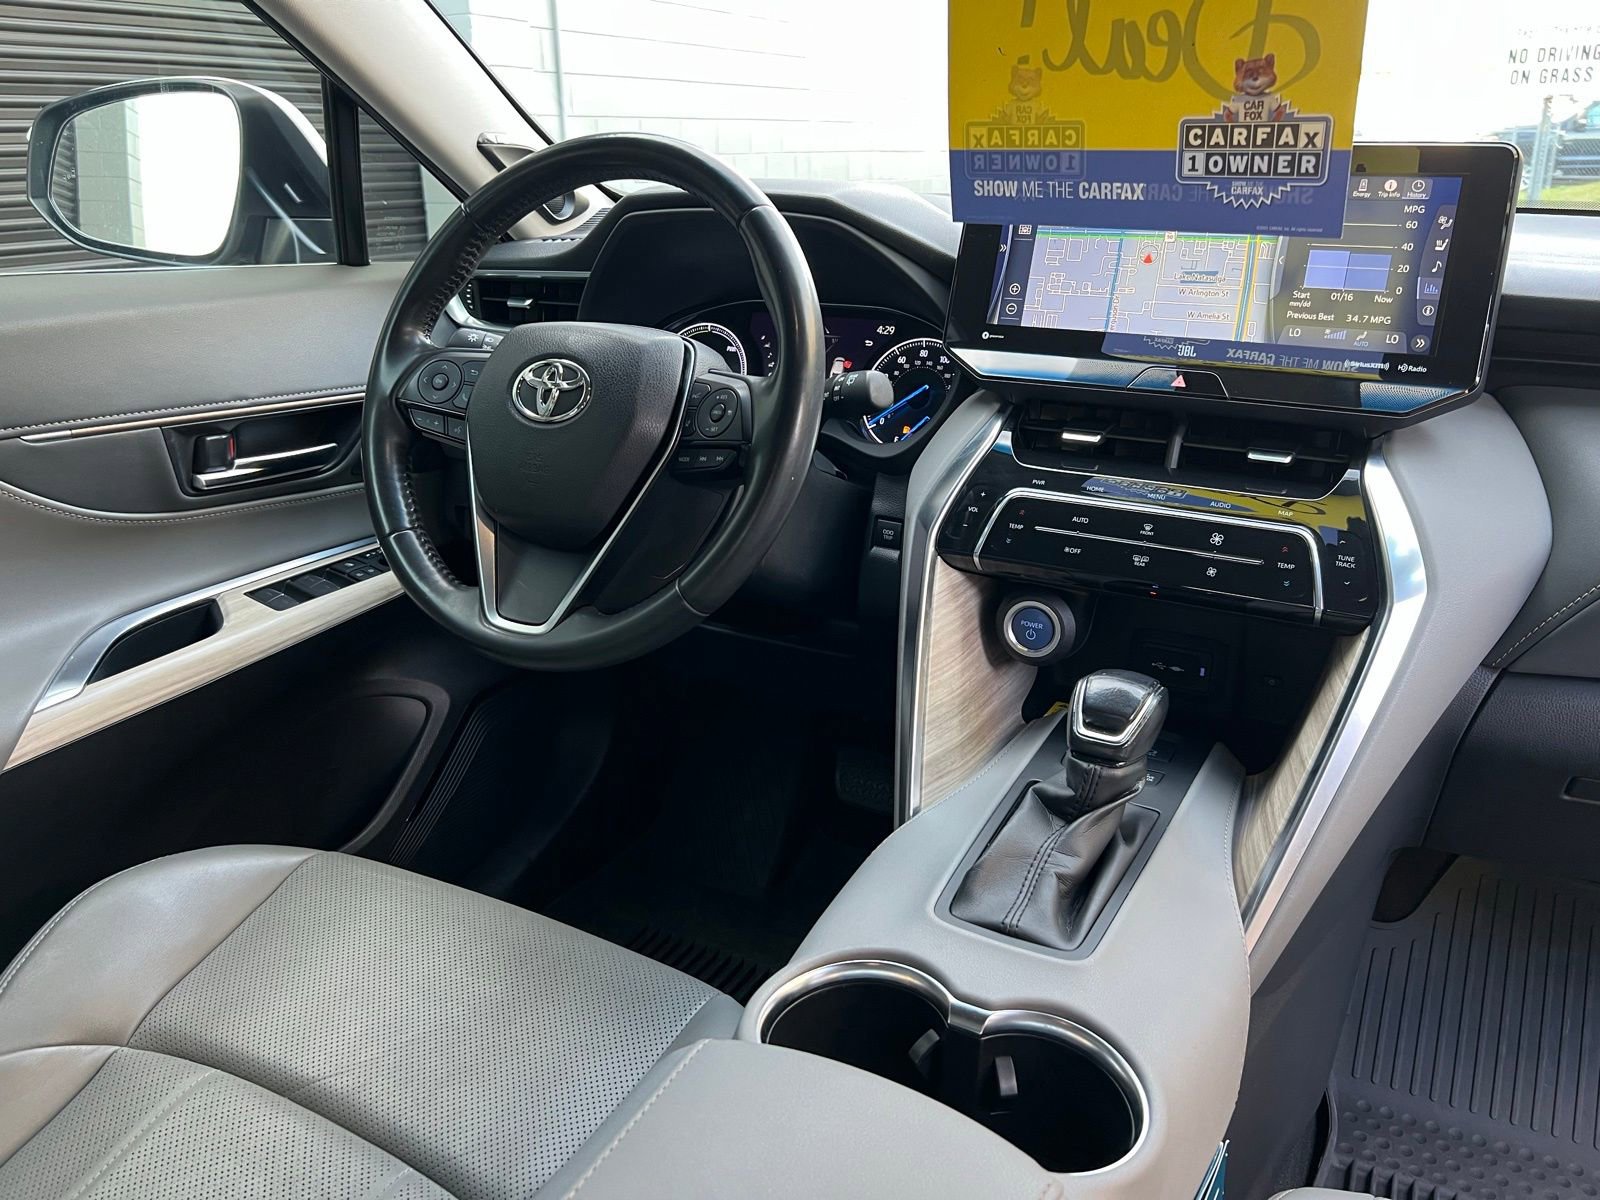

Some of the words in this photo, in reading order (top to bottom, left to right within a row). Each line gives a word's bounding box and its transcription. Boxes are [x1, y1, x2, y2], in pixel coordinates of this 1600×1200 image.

[1508, 48, 1528, 64] NO
[1510, 69, 1530, 85] ON
[1539, 66, 1594, 84] GRASS
[1243, 100, 1264, 111] CAR
[1243, 111, 1263, 121] FOX
[1188, 127, 1320, 148] CARFAX
[1187, 155, 1199, 173] 1
[1208, 154, 1316, 174] OWNER
[973, 180, 1017, 197] SHOW
[1022, 181, 1043, 198] ME
[1046, 181, 1074, 199] THE
[1078, 182, 1145, 200] CARFAX
[1231, 186, 1264, 195] CARFAX
[1404, 205, 1425, 214] MPG
[1405, 220, 1418, 229] 60
[1401, 242, 1414, 251] 40
[1397, 265, 1409, 273] 20
[1174, 273, 1190, 281] Lake
[1188, 288, 1220, 298] Arlington
[1395, 286, 1403, 295] 0
[1112, 295, 1120, 304] Dr
[1292, 290, 1311, 299] Start
[1330, 292, 1354, 301] 01/16
[1374, 295, 1393, 304] Now
[1289, 300, 1311, 308] mm/dd
[1196, 312, 1220, 320] Amelia
[1286, 310, 1316, 320] Previous
[1318, 313, 1335, 321] Best
[1345, 314, 1368, 323] 34.7
[1369, 316, 1392, 325] MPG
[876, 325, 896, 335] 4:29
[1288, 328, 1302, 337] LO
[1385, 335, 1399, 344] LO
[919, 349, 929, 358] 80
[1177, 344, 1197, 357] JBL
[897, 356, 907, 364] 60
[1408, 365, 1428, 373] Radio
[879, 417, 885, 425] 0
[1146, 493, 1166, 501] MENU
[1210, 501, 1232, 509] AUDIO
[1277, 510, 1294, 518] MAP
[1071, 516, 1089, 524] AUTO
[1337, 554, 1356, 562] TUNE
[1277, 562, 1296, 570] TEMP
[1335, 561, 1356, 569] TRACK
[1020, 620, 1044, 630] POWER
